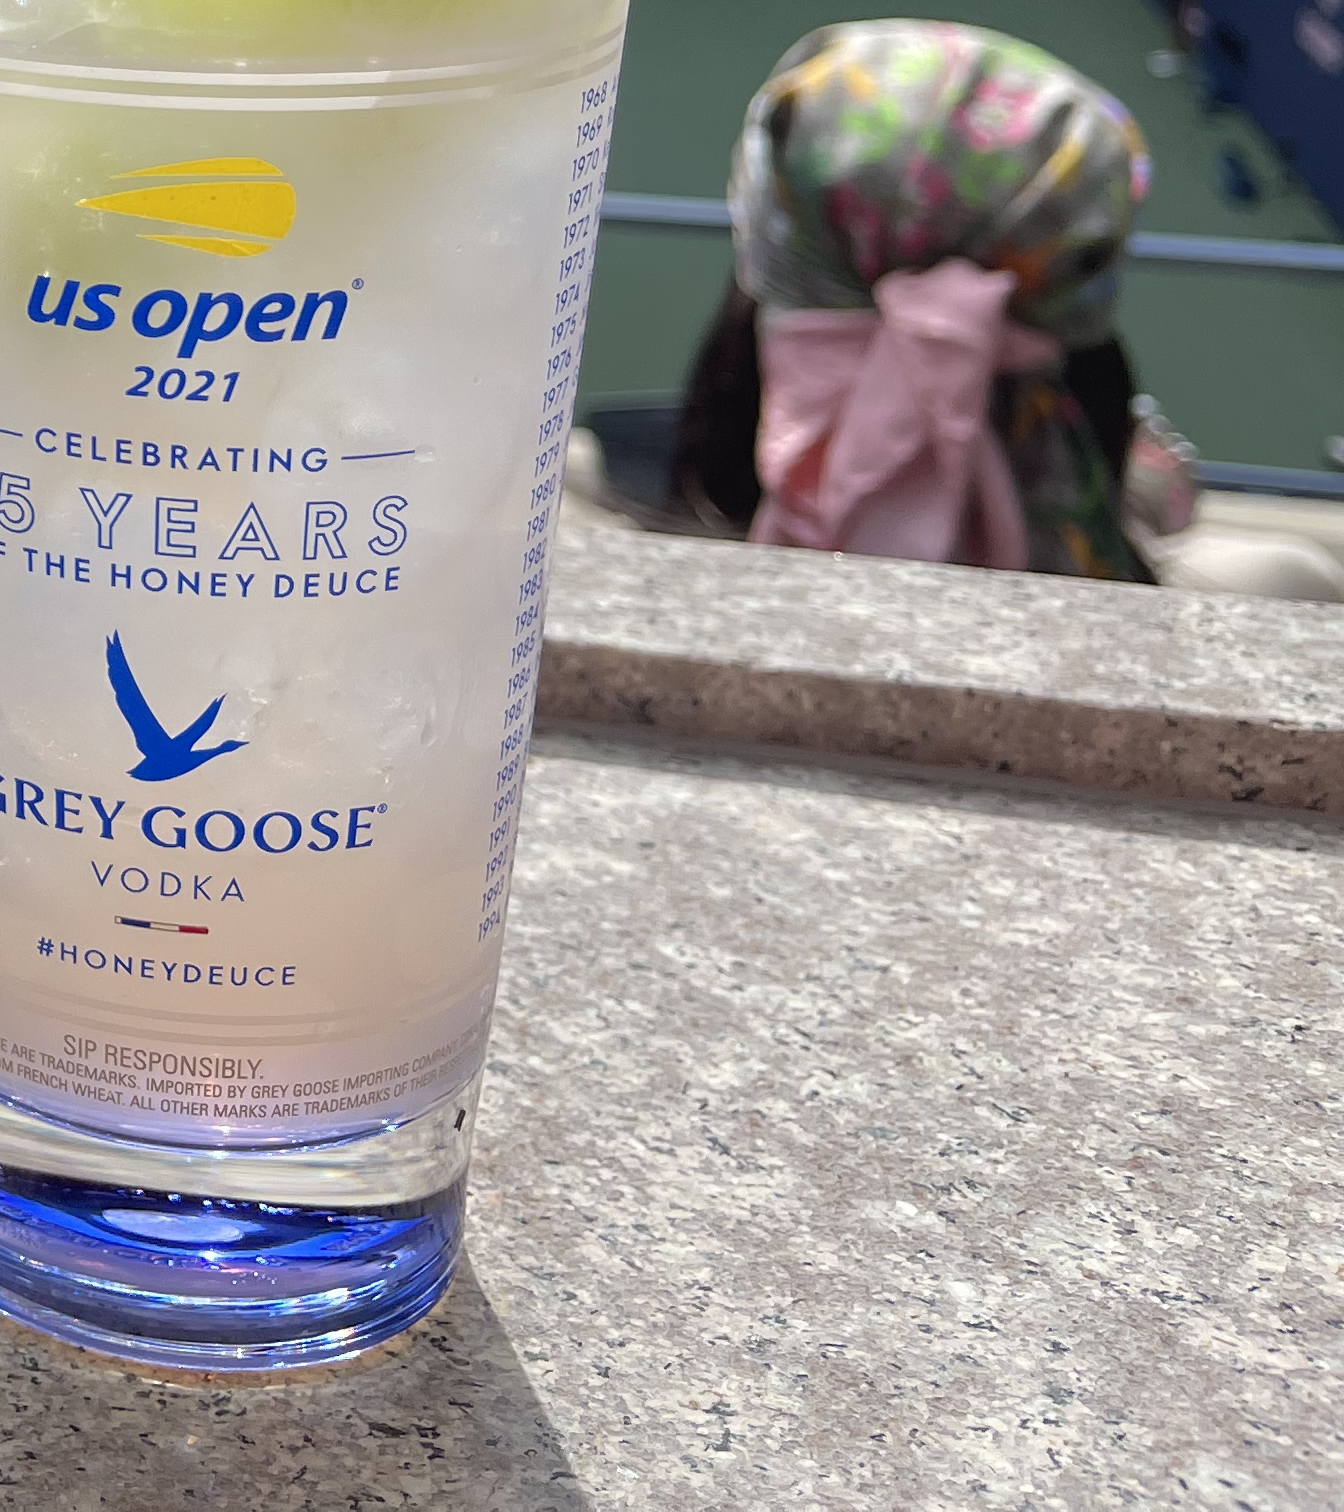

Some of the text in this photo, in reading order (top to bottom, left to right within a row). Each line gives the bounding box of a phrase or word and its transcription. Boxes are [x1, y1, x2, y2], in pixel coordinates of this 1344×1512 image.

[581, 80, 607, 113] 1968
[577, 114, 603, 148] 1969
[572, 148, 599, 181] 1970
[568, 182, 593, 215] 1971
[564, 215, 590, 248] 1972
[560, 248, 586, 282] 1973
[26, 273, 122, 333] us
[555, 282, 580, 315] 1974
[551, 313, 577, 348] 1975
[547, 347, 572, 380] 1976
[126, 365, 241, 403] 2021
[543, 377, 569, 413] 1977
[539, 410, 564, 446] 1978
[35, 428, 329, 474] CELEBRATING
[535, 442, 560, 478] 1979
[531, 473, 556, 510] 1980
[80, 488, 410, 563] YEARS
[527, 507, 550, 541] 1981
[22, 546, 91, 584] THE
[111, 562, 255, 599] HONEY
[274, 566, 400, 599] DEUCE
[523, 538, 546, 573] 1982
[518, 570, 544, 605] 1983
[515, 600, 538, 636] 1984
[511, 630, 535, 668] 1985
[508, 661, 530, 698] 1986
[504, 692, 528, 729] 1987
[500, 724, 523, 760] 1988
[496, 755, 520, 791] 1989
[493, 784, 516, 822] 1990
[489, 817, 511, 852] 1991
[91, 860, 246, 903] VODKA
[486, 845, 508, 882] 1992
[482, 875, 505, 913] 1993
[478, 906, 500, 942] 1994
[37, 935, 297, 987] #HONEYDEUCE
[12, 1043, 36, 1063] ARE
[39, 1052, 141, 1089] TRADEMARKS.
[146, 1078, 221, 1098] IMPORTED
[228, 1085, 246, 1099] BY
[251, 1084, 289, 1099] GREY
[293, 1079, 339, 1097] GOOSE
[343, 1062, 409, 1091] IMPORTING
[64, 1034, 264, 1080] SIP RESPONSIBLY.
[17, 1063, 68, 1092] FRENCH
[72, 1081, 125, 1106] WHEAT.
[130, 1095, 155, 1111] ALL
[161, 1099, 208, 1117] OTHER
[214, 1104, 267, 1118] MARKS
[271, 1103, 299, 1118] ARE
[305, 1087, 391, 1116] TRADEMARKS
[393, 1085, 408, 1098] OF
[410, 1069, 437, 1091] THEIR
